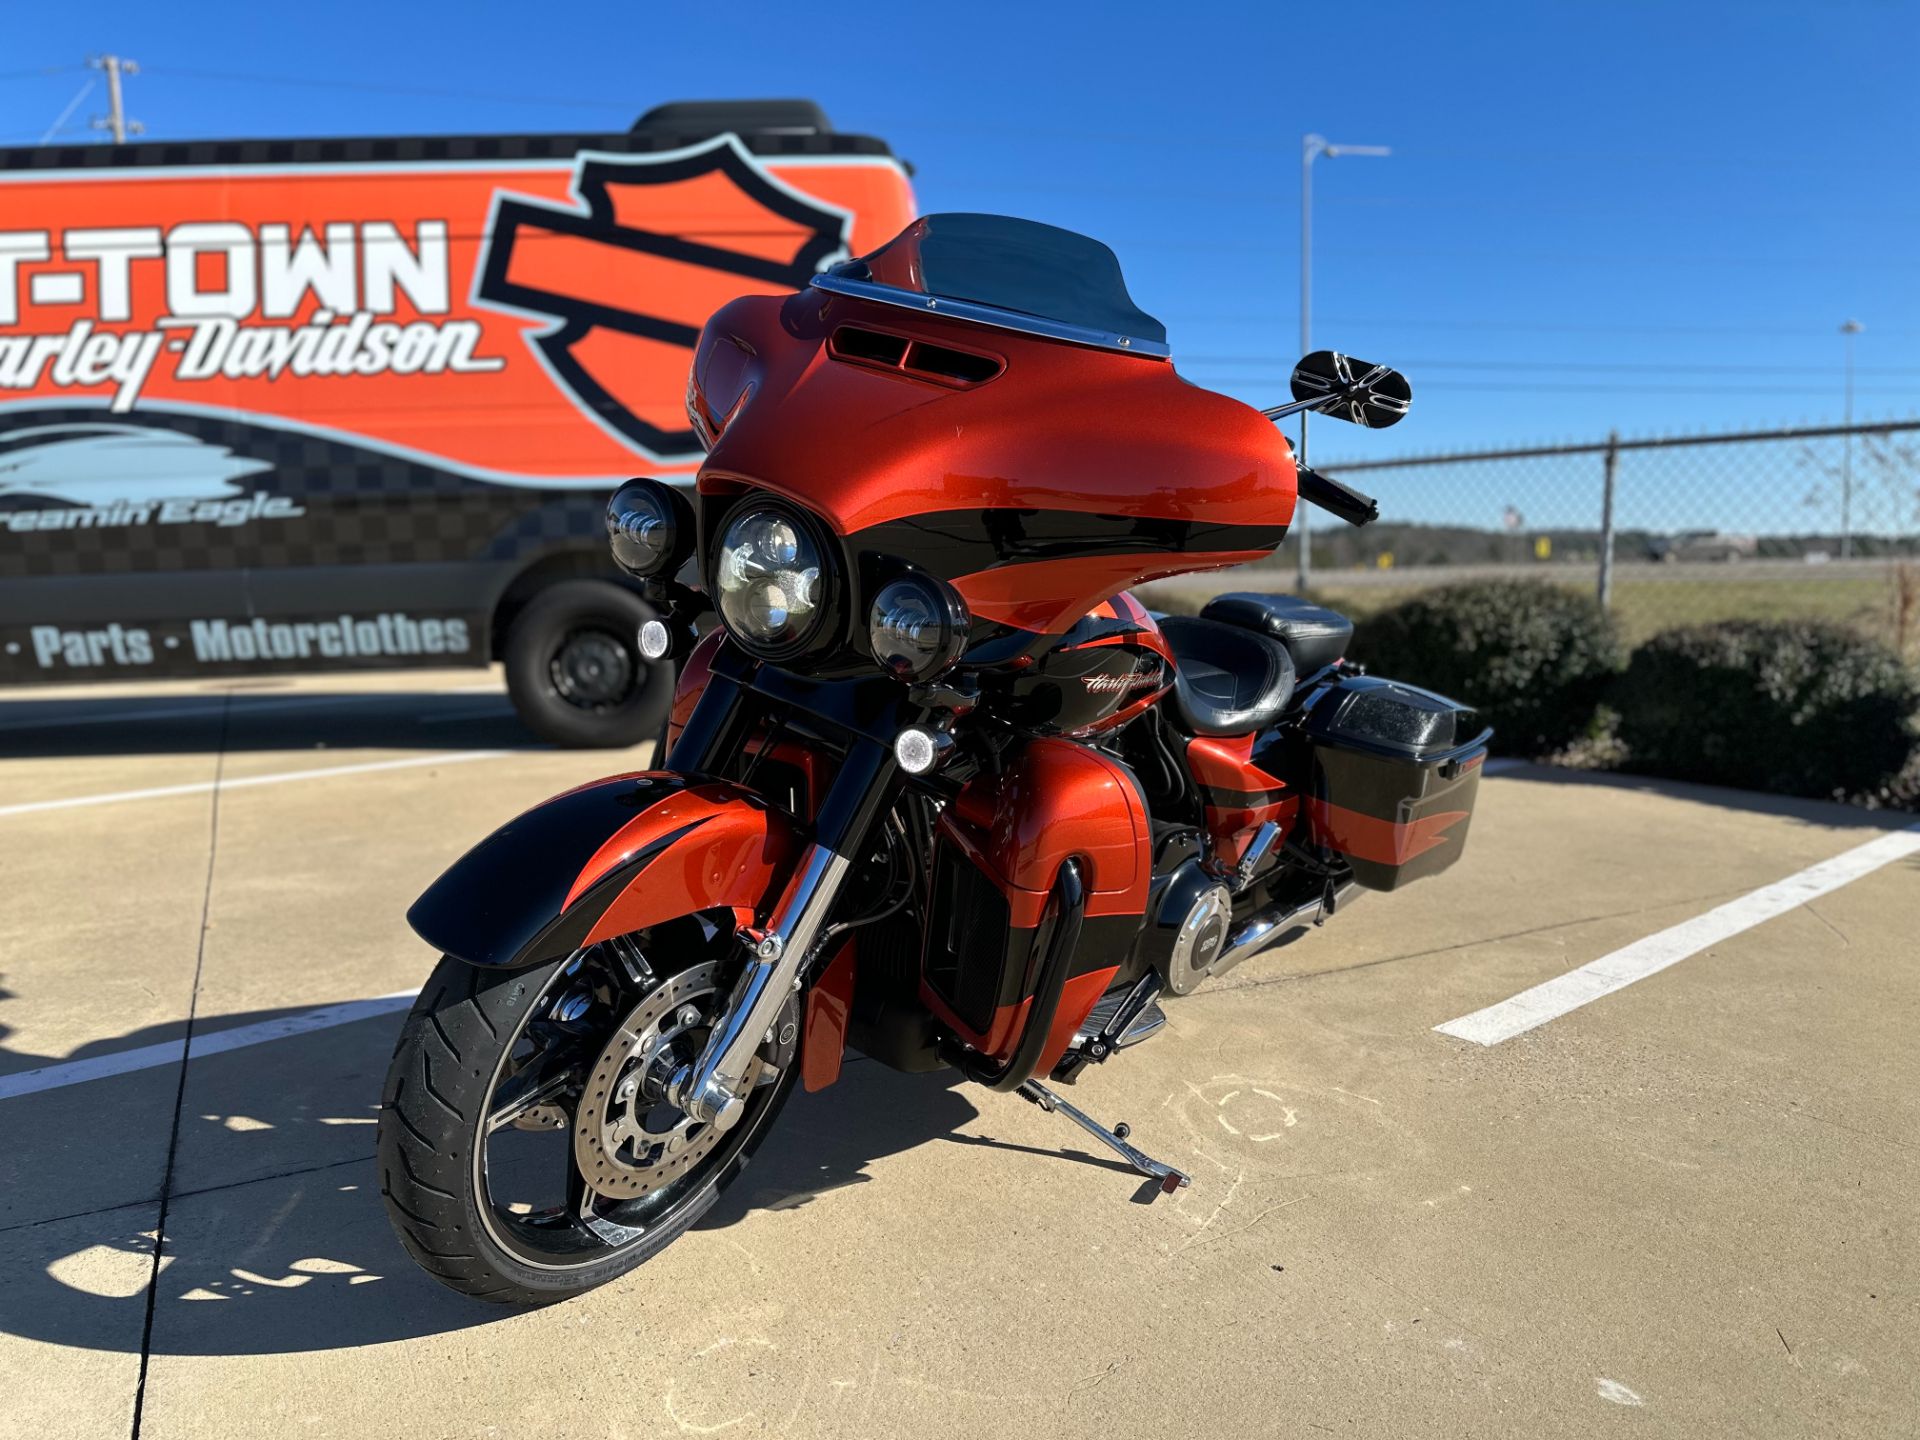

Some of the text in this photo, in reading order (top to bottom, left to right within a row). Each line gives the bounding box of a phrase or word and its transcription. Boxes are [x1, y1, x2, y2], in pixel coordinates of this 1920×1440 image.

[0, 220, 450, 325] T-TOWN
[157, 491, 306, 527] Eagle
[30, 612, 470, 668] Parts Motorclothes
